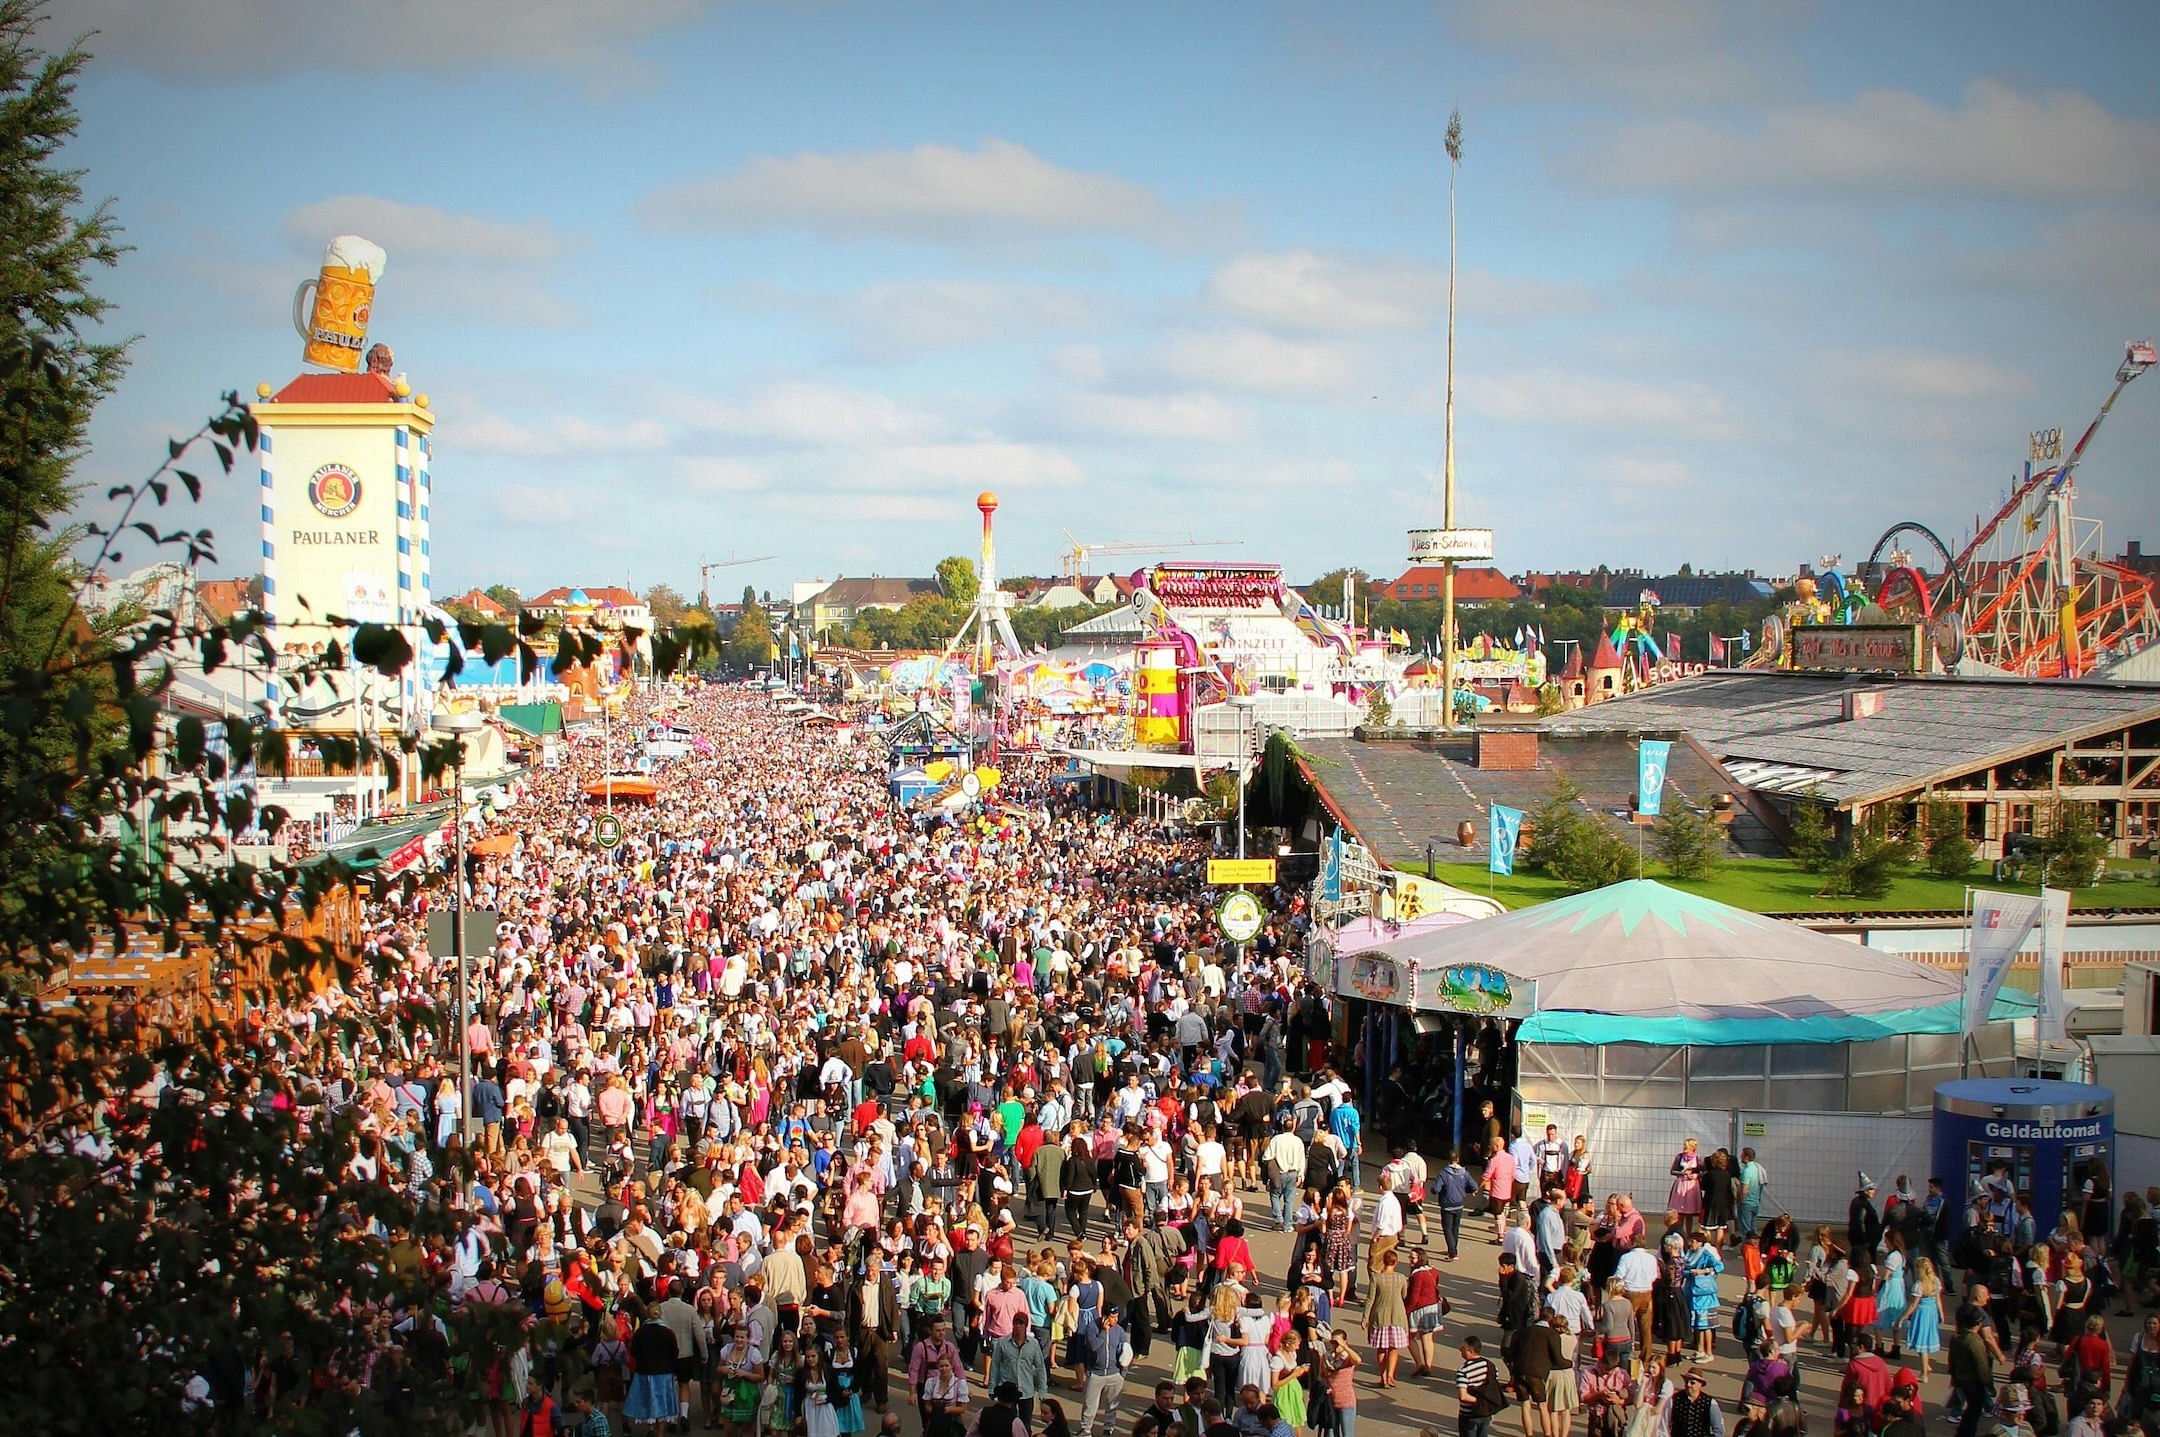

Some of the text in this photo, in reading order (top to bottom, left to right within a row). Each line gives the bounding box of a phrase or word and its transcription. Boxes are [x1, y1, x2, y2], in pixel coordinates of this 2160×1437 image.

[310, 464, 360, 484] PAULANER
[292, 530, 381, 545] PAULANER
[1985, 1121, 2101, 1139] Geldautomat
